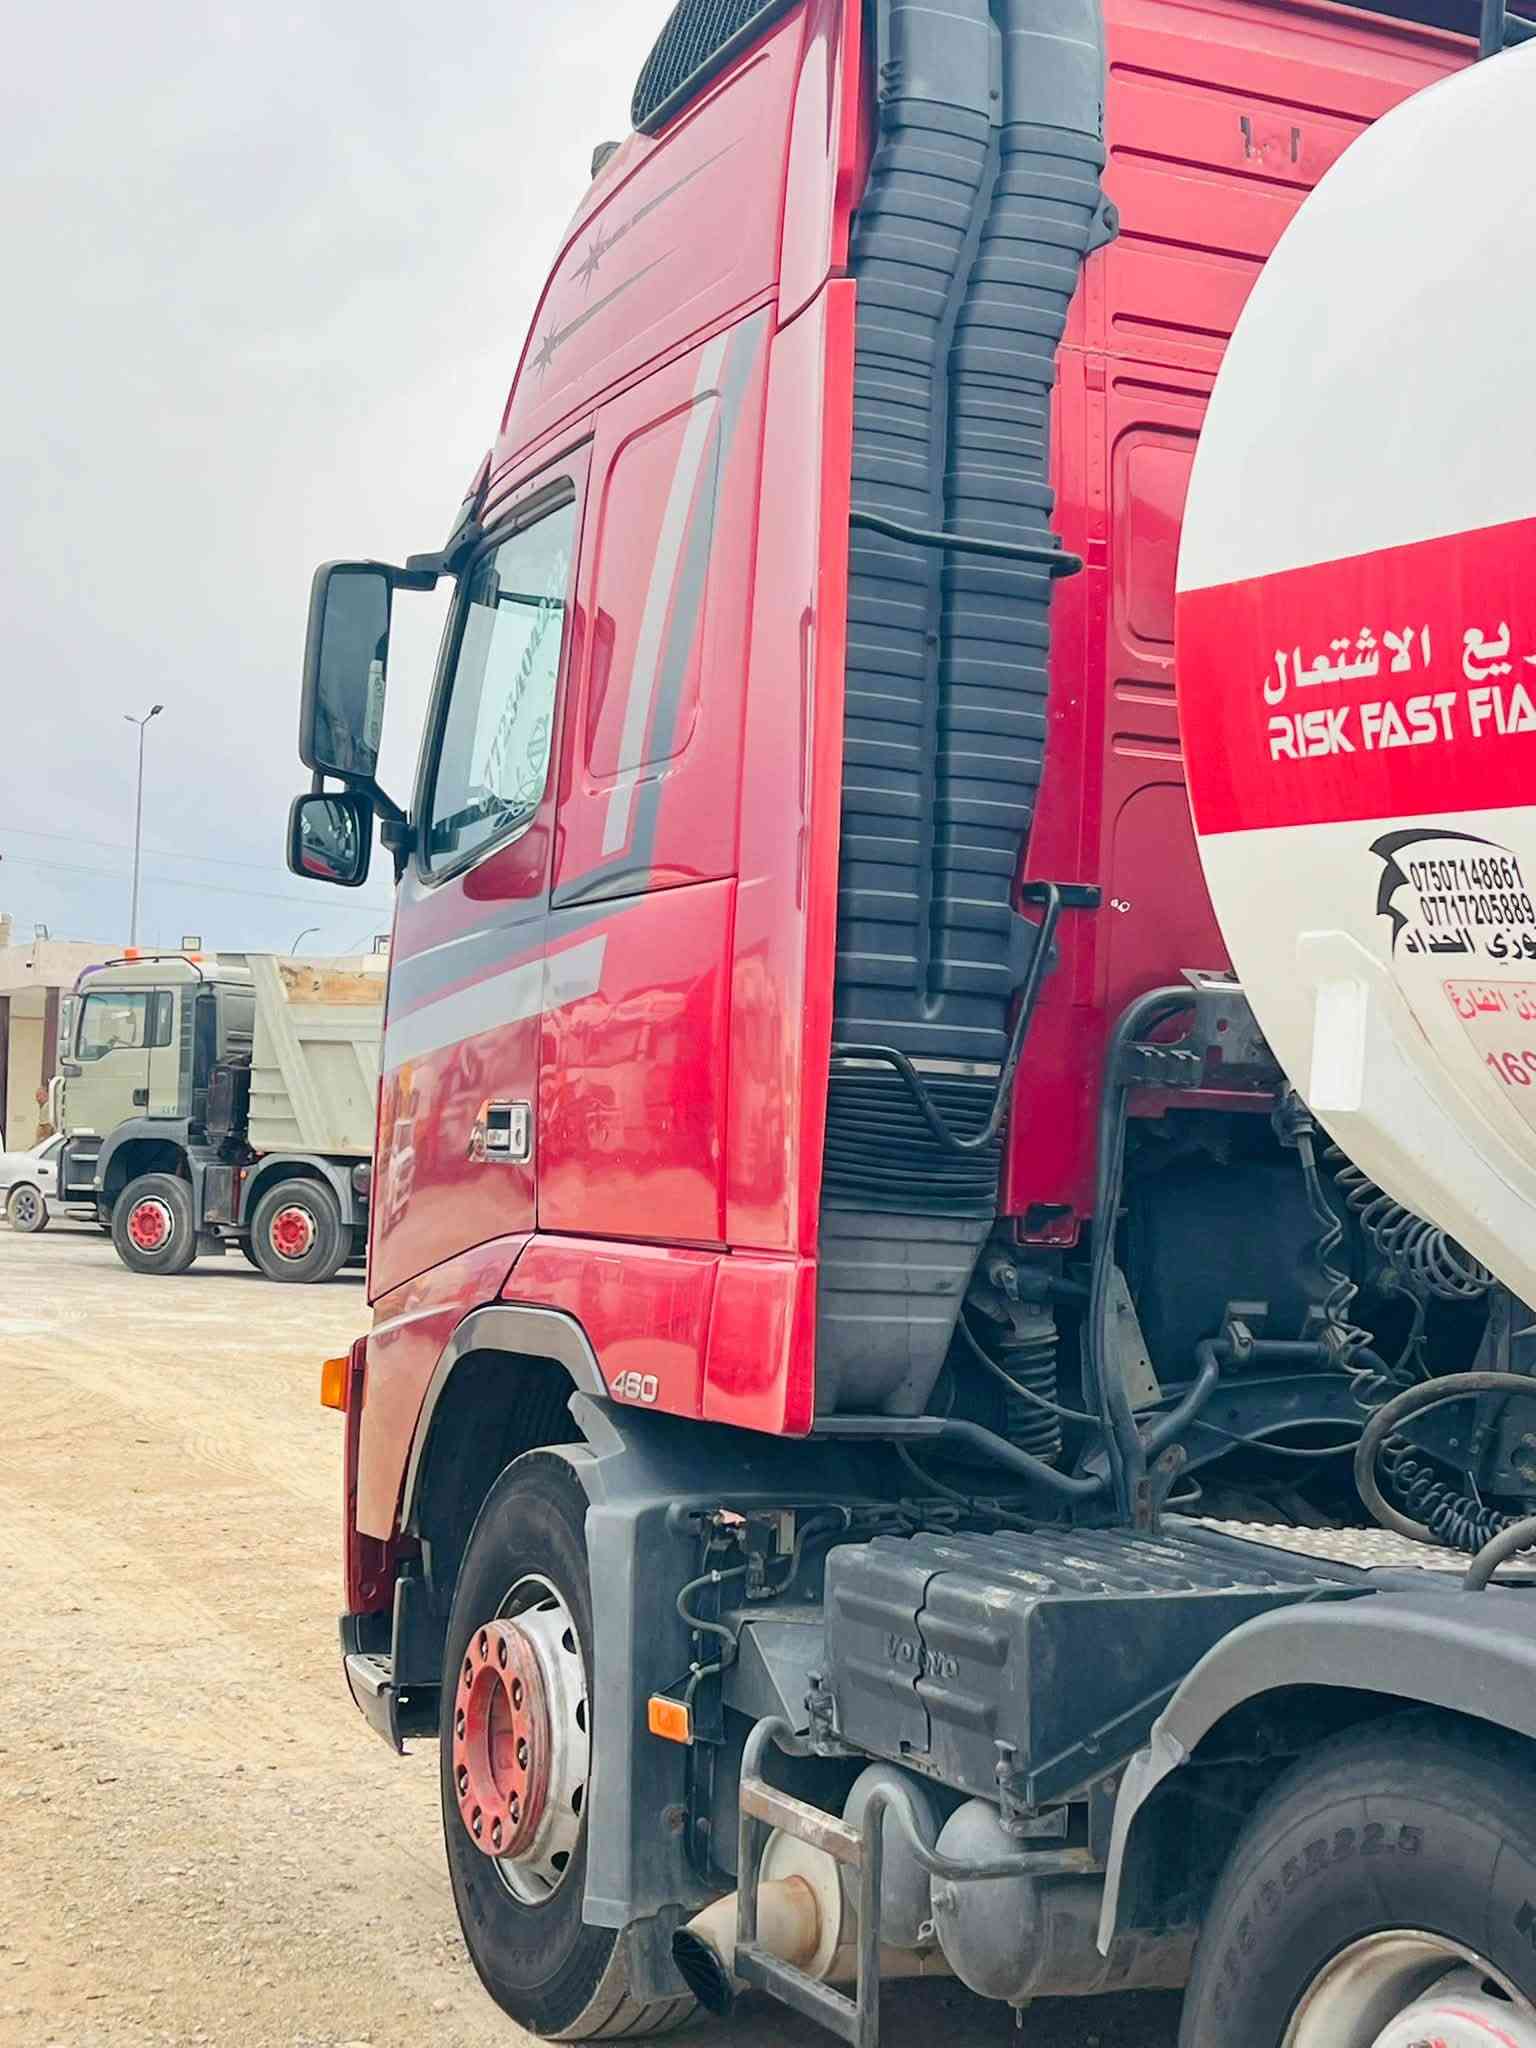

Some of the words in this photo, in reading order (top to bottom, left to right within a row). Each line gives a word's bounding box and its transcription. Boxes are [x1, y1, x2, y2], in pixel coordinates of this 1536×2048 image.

[1264, 623, 1431, 705] الاشتعال
[1267, 706, 1356, 761] RISK
[1360, 691, 1457, 751] FAST
[1409, 855, 1525, 892] 07507148861
[1420, 892, 1536, 927] 07717205889
[609, 1369, 658, 1402] 460
